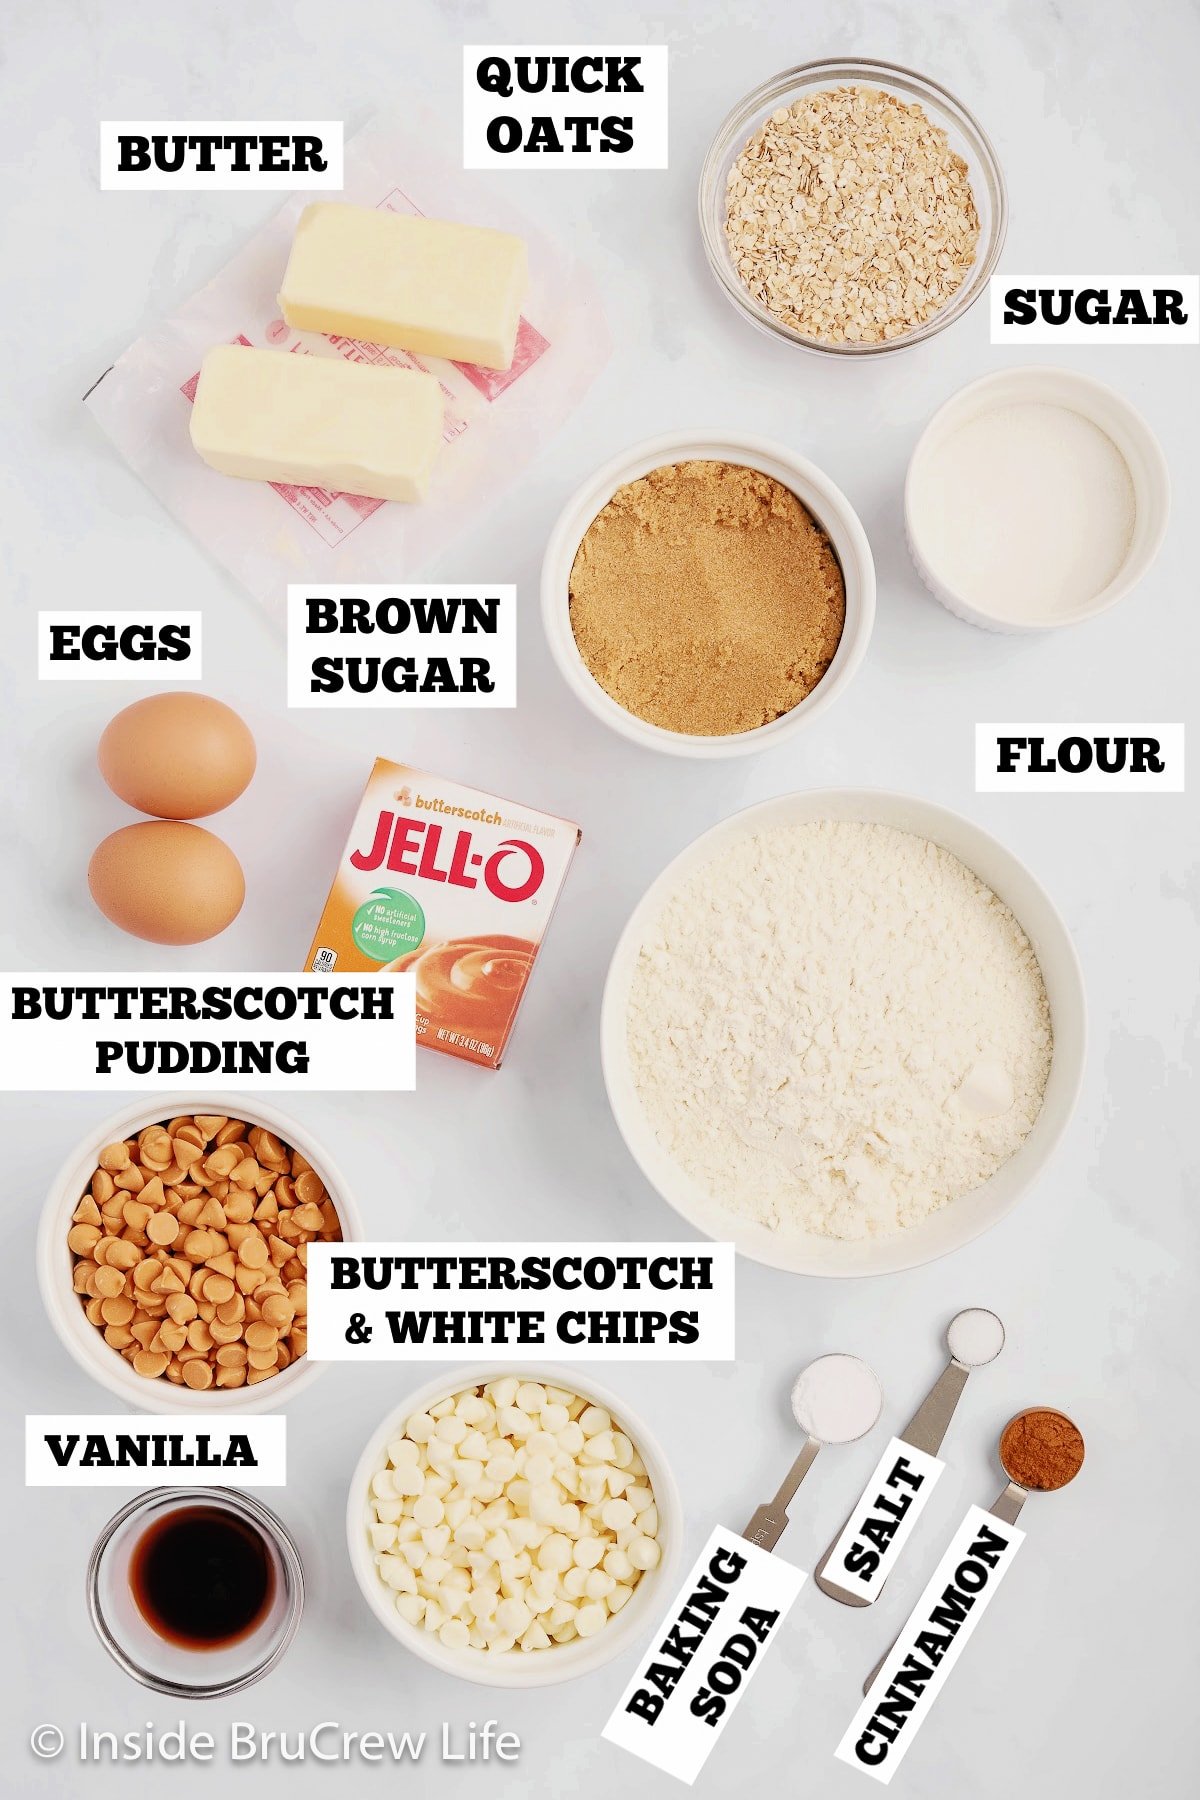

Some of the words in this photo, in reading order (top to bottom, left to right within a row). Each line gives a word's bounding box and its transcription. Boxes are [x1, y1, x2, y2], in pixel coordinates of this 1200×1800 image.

[415, 794, 502, 826] butterscotch
[350, 810, 544, 903] JELL-O
[374, 914, 411, 928] sweeteners
[375, 905, 385, 914] NO
[386, 909, 417, 921] artificial
[362, 932, 376, 941] corn
[378, 936, 396, 947] syrup
[363, 923, 373, 932] NO
[374, 926, 389, 936] high
[391, 929, 419, 942] fructose
[320, 950, 333, 962] 90
[436, 1027, 450, 1041] NET
[448, 1031, 460, 1045] WT
